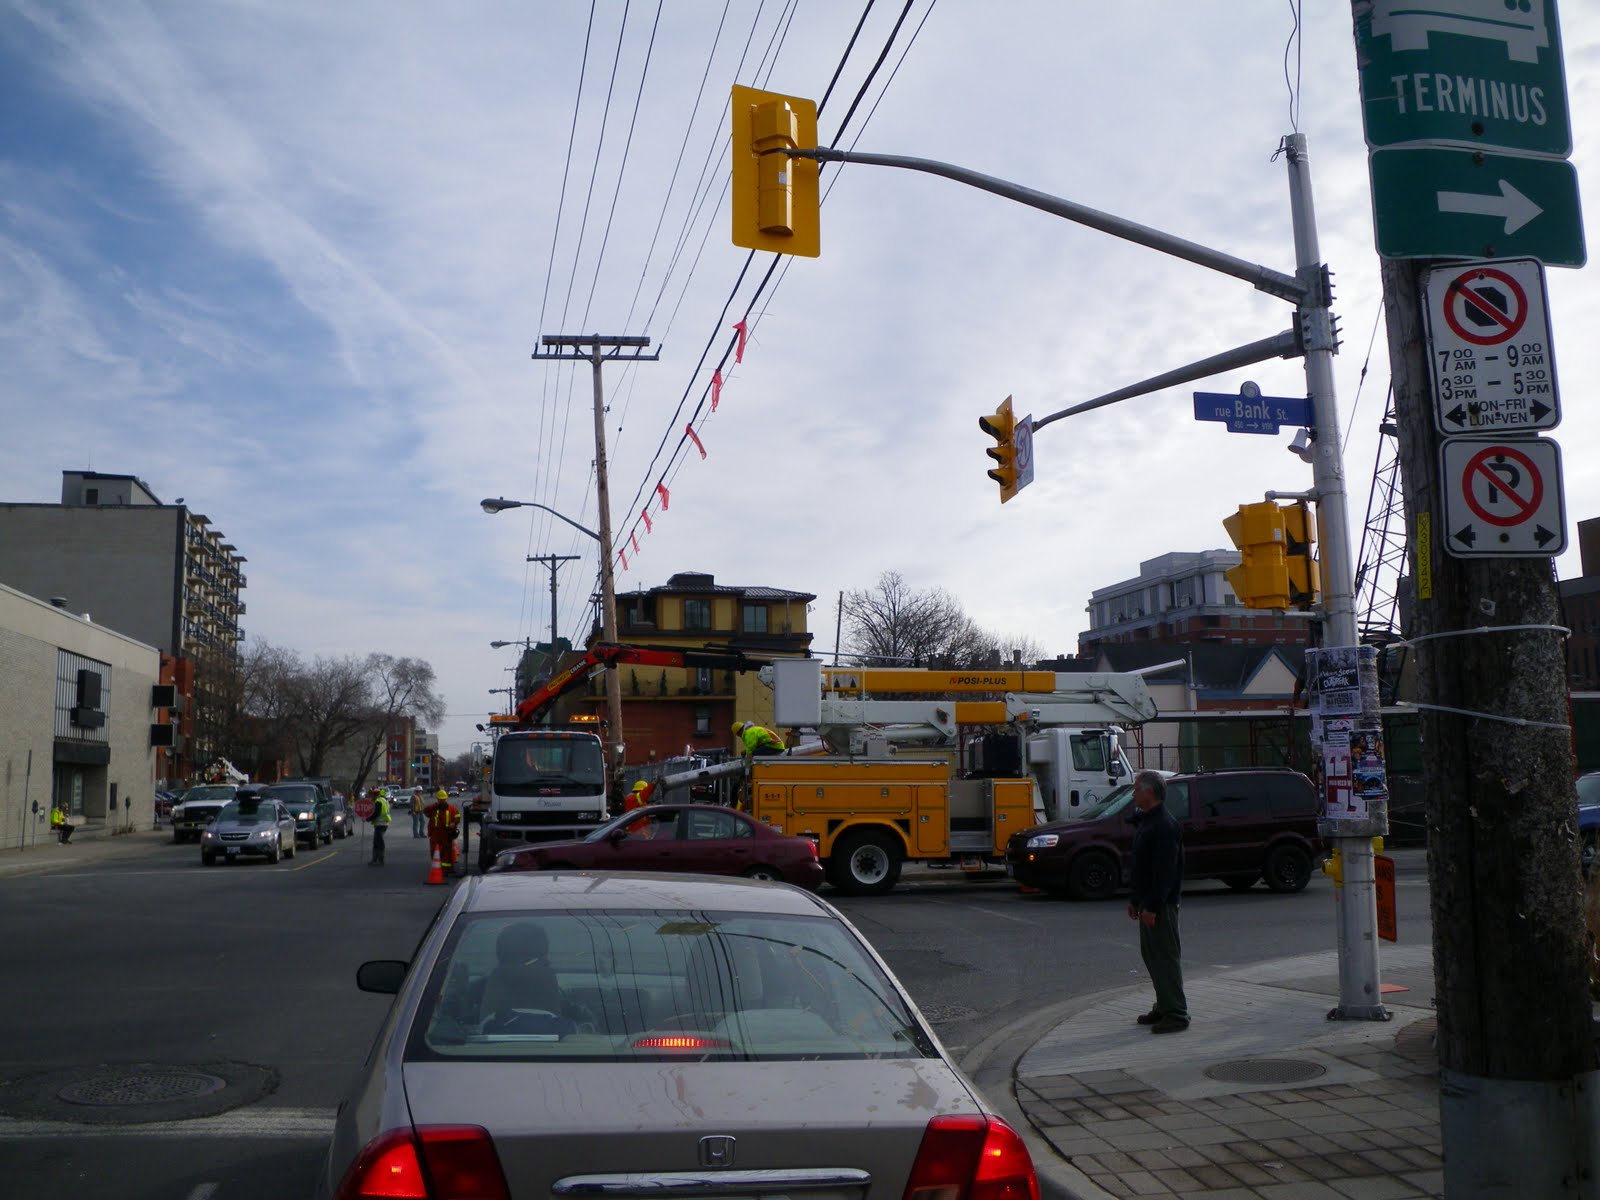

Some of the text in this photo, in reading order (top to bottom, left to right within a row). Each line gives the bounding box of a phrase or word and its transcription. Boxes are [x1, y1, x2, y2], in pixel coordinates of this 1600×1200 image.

[1391, 72, 1547, 126] TERMINUS
[1453, 348, 1473, 359] 00
[1521, 342, 1542, 353] 00
[1438, 350, 1450, 372] 7
[1506, 344, 1519, 368] 9
[1522, 355, 1544, 366] AM
[1454, 360, 1476, 371] AM
[1453, 374, 1474, 385] 30
[1526, 369, 1546, 380] 30
[1441, 377, 1453, 401] 3
[1513, 372, 1524, 395] 5
[1526, 383, 1550, 395] PM
[1454, 388, 1478, 400] PM
[1214, 407, 1231, 418] rue
[1234, 400, 1271, 420] Bank
[569, 658, 588, 675] CRANE
[355, 803, 374, 812] STOP
